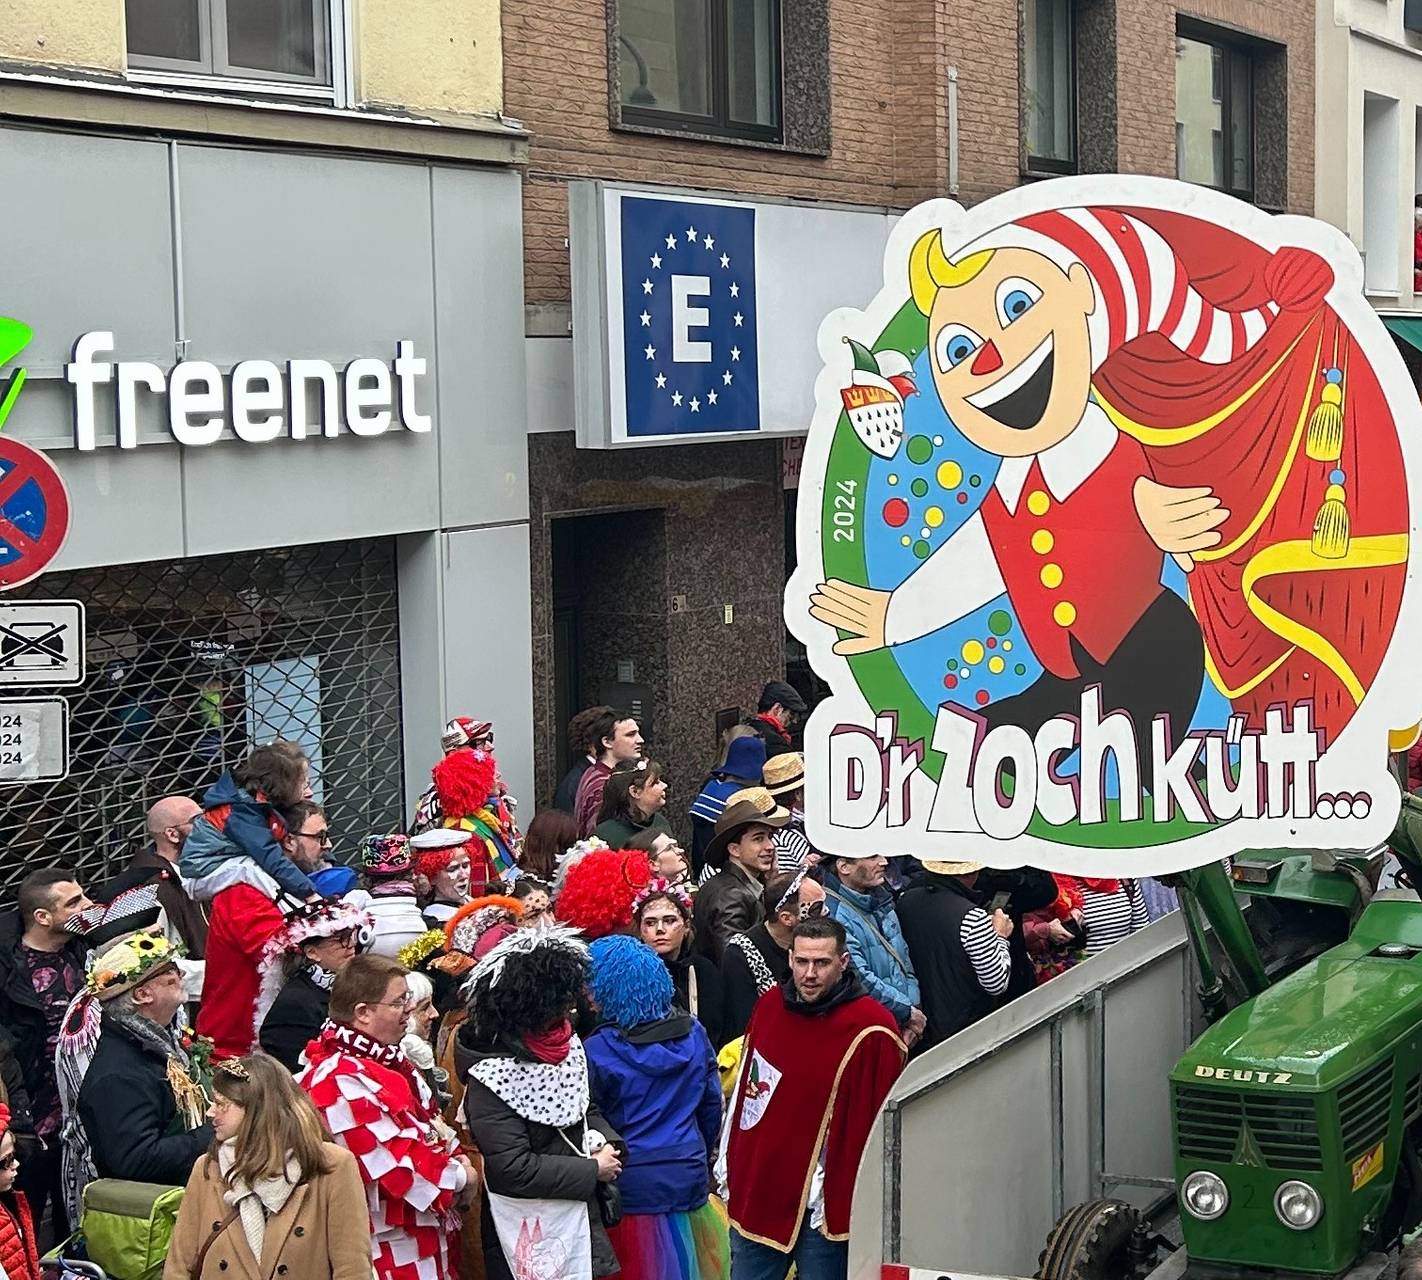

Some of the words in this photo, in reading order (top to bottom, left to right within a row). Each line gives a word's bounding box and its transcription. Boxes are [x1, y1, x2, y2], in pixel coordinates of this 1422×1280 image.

[671, 274, 712, 363] E
[64, 331, 431, 450] freenet
[833, 480, 857, 542] 2024
[829, 711, 924, 829] D'r
[926, 681, 1143, 840] Zoch
[1194, 1065, 1293, 1085] DEUTZ
